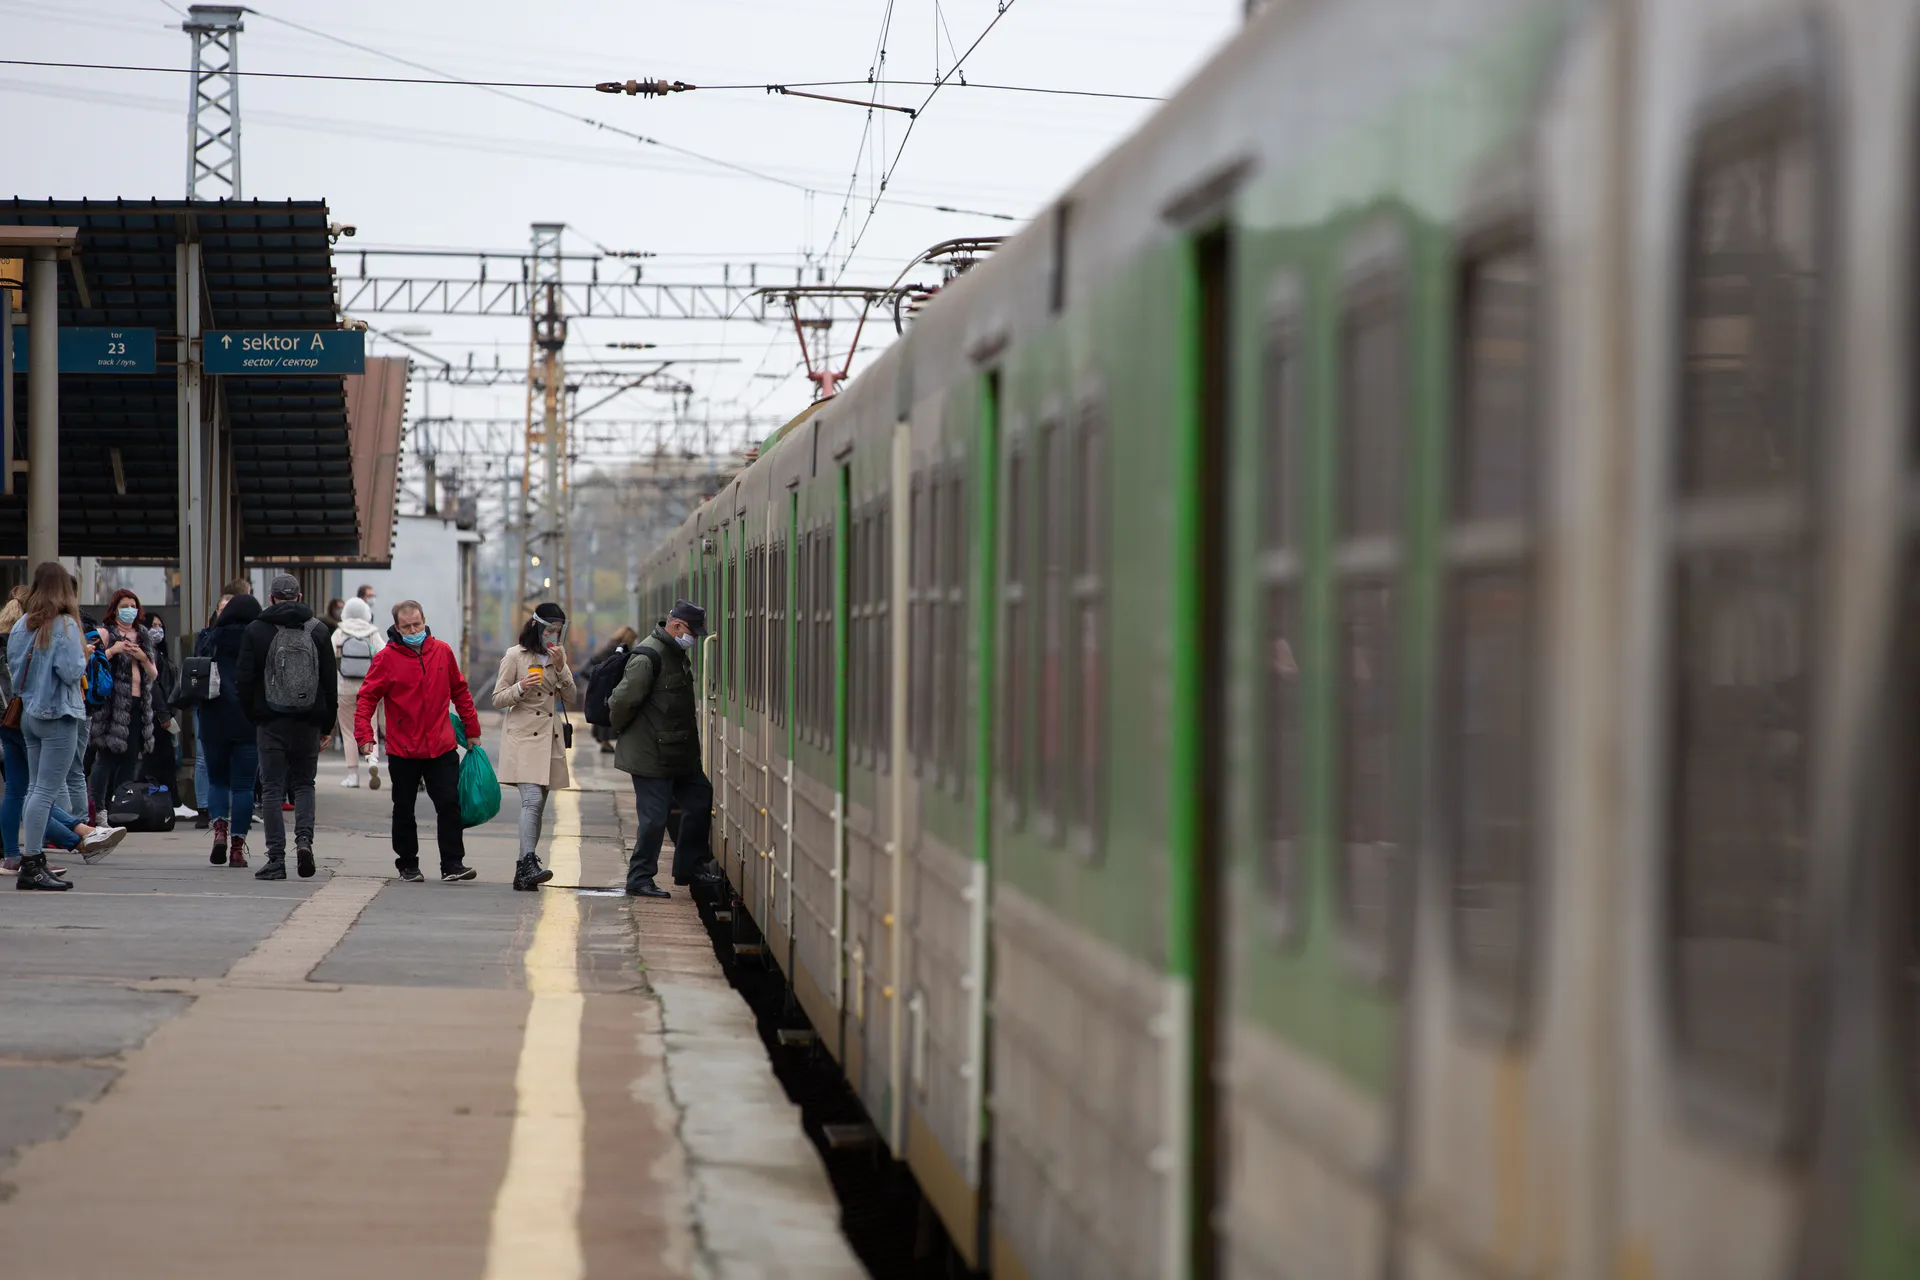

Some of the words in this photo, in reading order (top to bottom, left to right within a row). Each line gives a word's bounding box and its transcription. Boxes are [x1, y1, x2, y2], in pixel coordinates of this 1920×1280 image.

[108, 342, 126, 354] 23
[242, 333, 300, 351] sektor
[310, 333, 325, 350] A
[242, 358, 274, 367] sector
[282, 358, 319, 368] сектор
